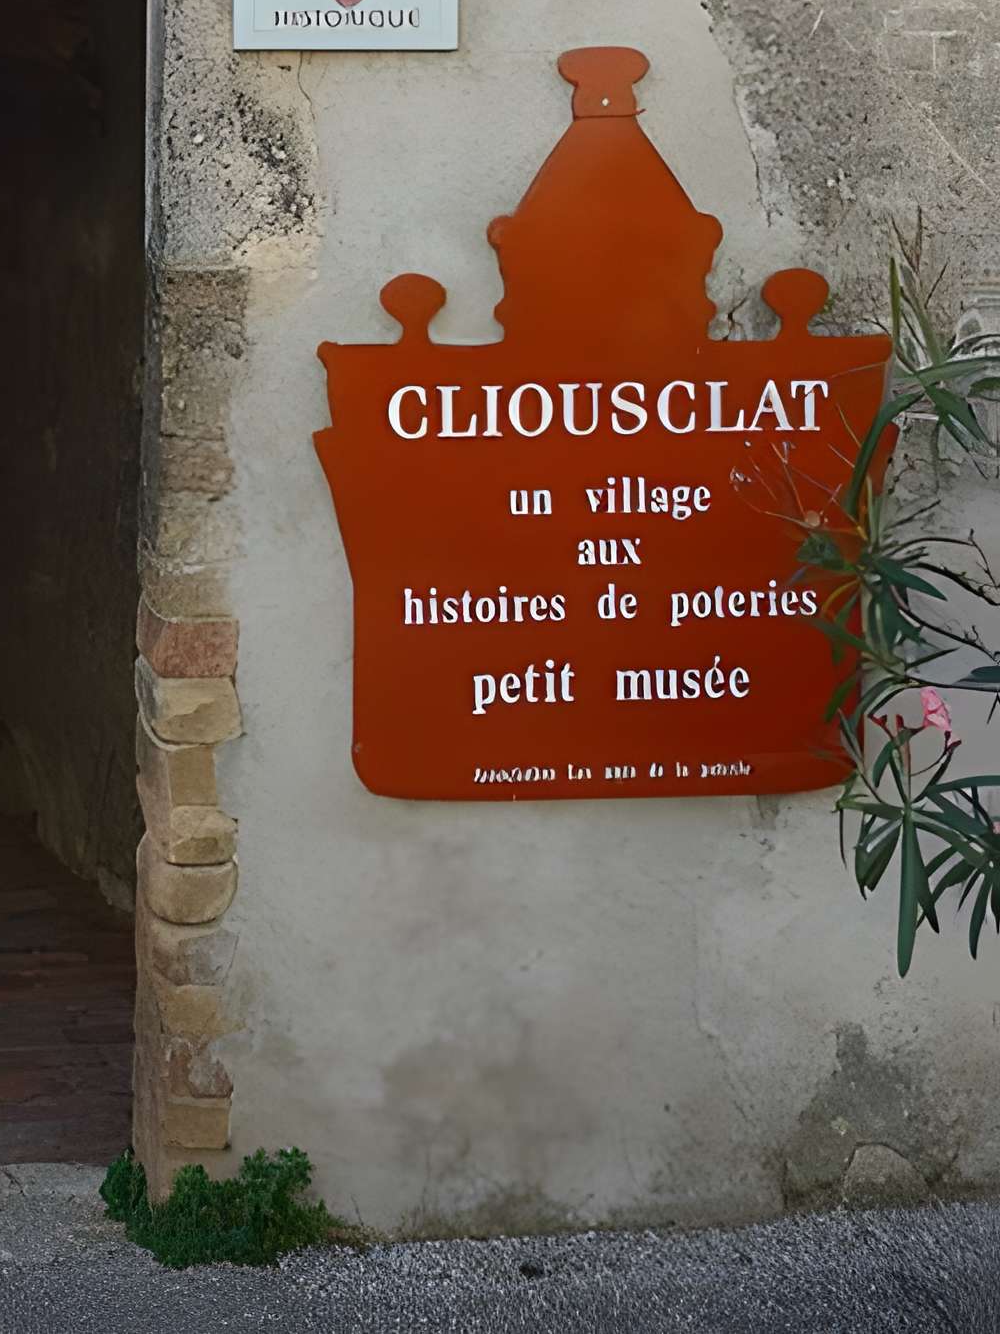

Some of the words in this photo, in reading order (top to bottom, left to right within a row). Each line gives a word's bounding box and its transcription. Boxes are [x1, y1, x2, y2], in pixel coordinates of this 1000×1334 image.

[388, 379, 829, 440] CLIOUSCLAT
[509, 488, 553, 516] un
[585, 476, 712, 521] village
[577, 537, 642, 566] aux
[403, 585, 567, 626] histoires
[597, 583, 638, 620] de
[670, 579, 818, 627] poteries
[472, 659, 576, 715] petit
[615, 654, 751, 701] musée
